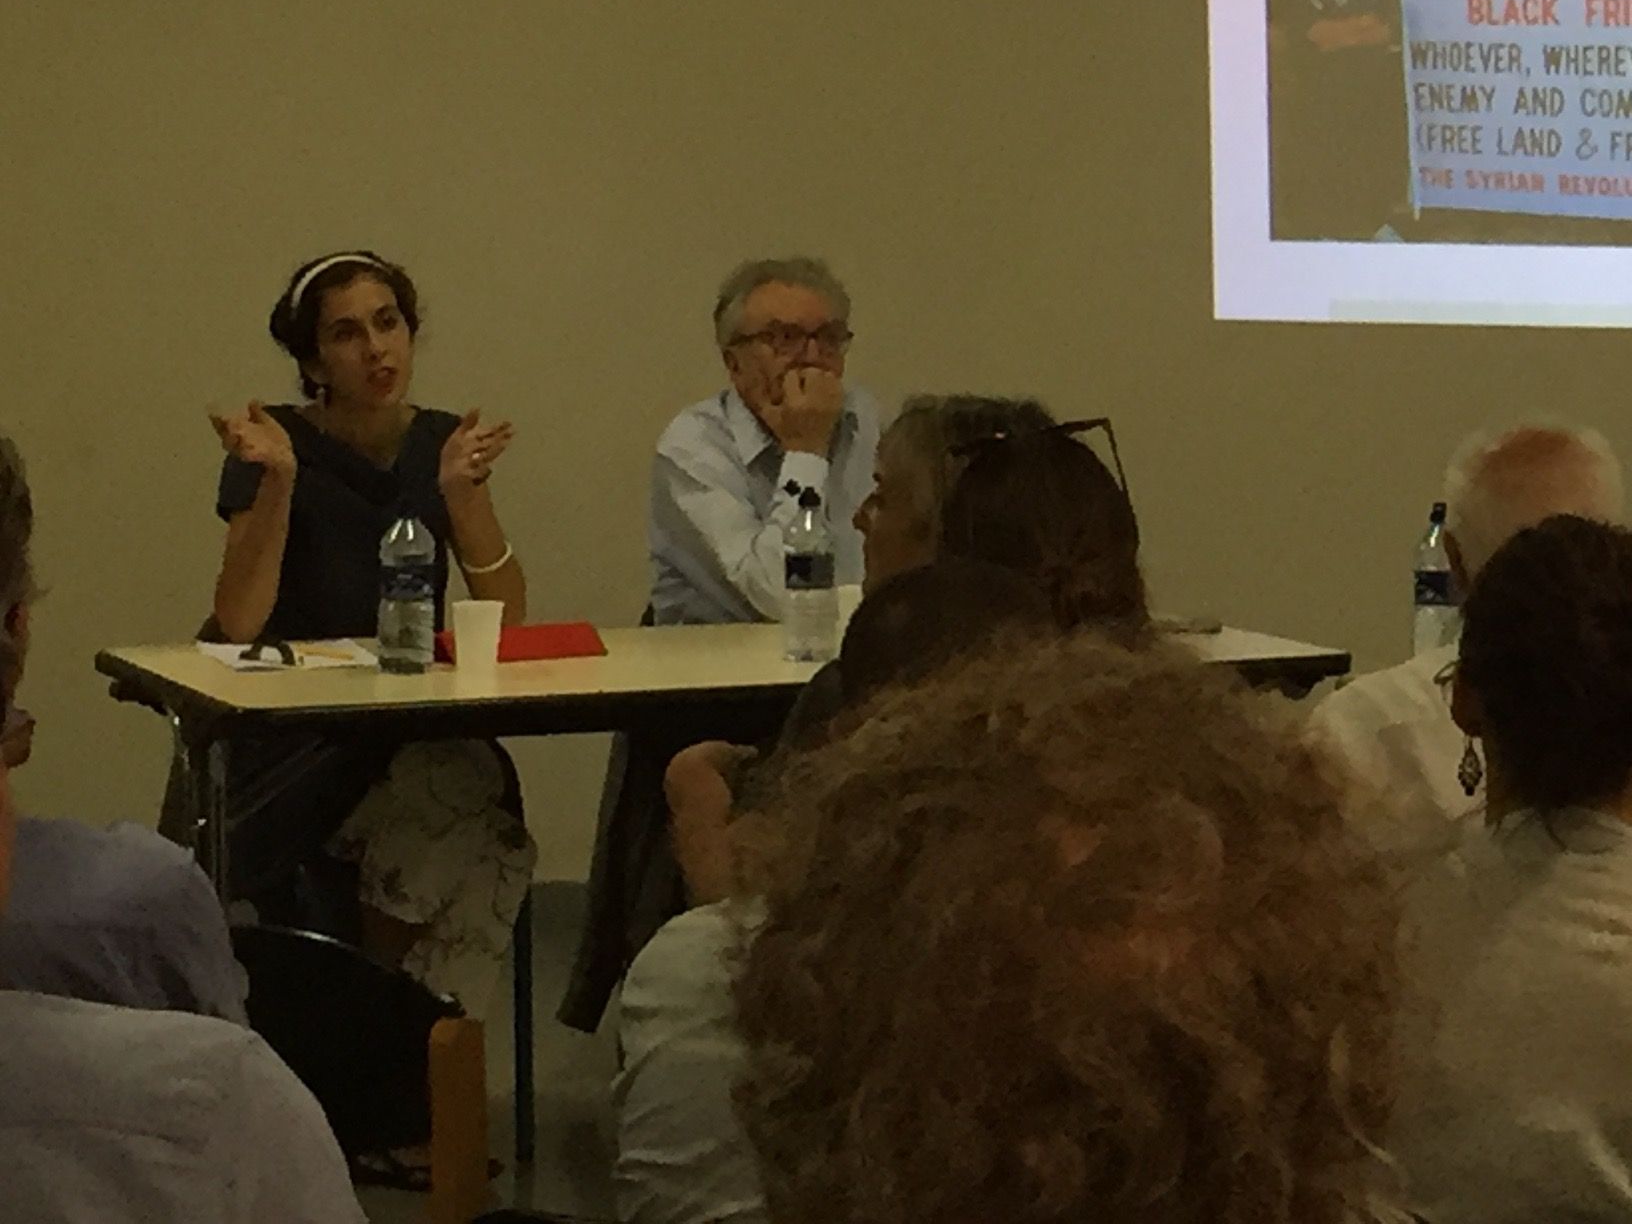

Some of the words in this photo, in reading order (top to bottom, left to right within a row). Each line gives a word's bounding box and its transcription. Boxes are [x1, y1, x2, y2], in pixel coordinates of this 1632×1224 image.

[1409, 40, 1532, 77] WHOEVER,
[1412, 81, 1496, 114] ENEMY
[1512, 86, 1566, 117] AND
[1415, 123, 1484, 156] (FREE
[1495, 126, 1563, 159] LAND
[1574, 126, 1600, 162] &
[1418, 165, 1454, 190] THE
[1463, 168, 1546, 194] SYRIAN
